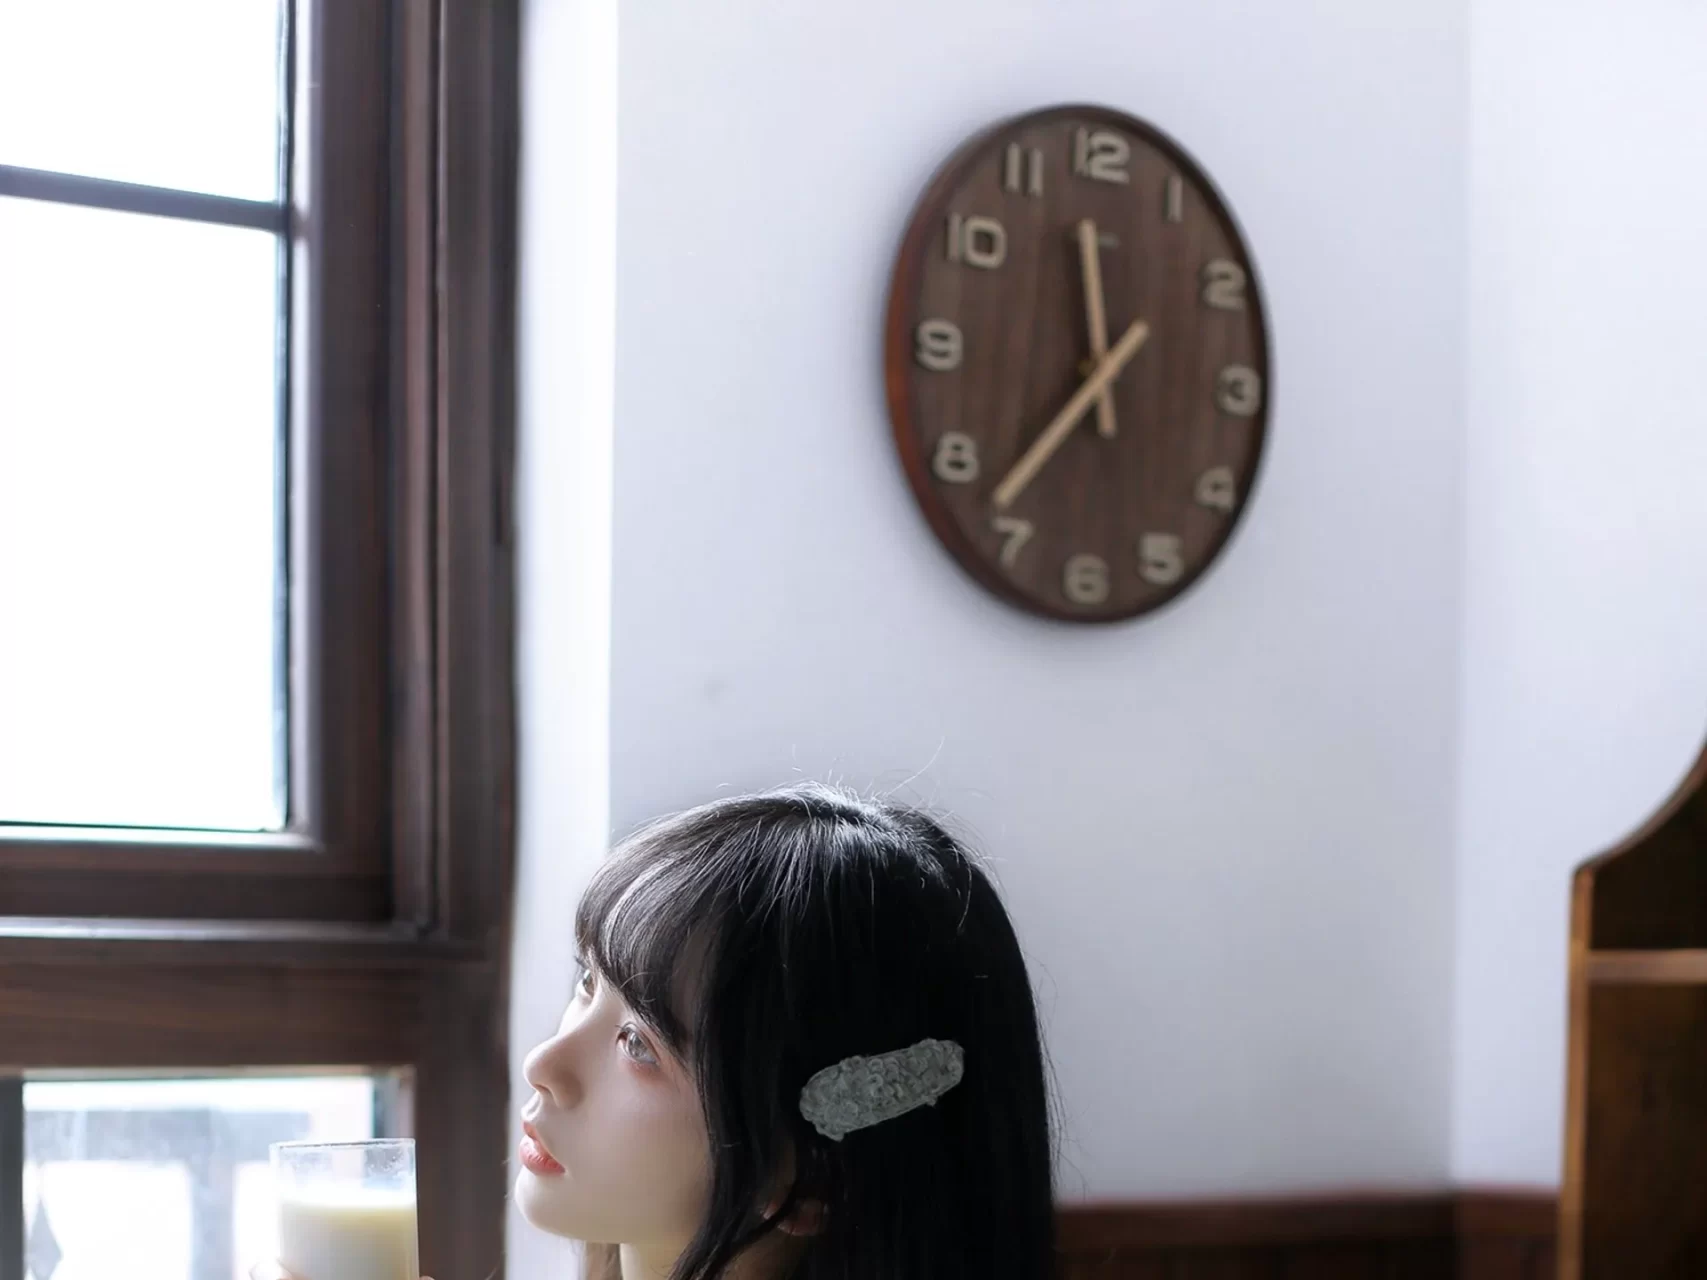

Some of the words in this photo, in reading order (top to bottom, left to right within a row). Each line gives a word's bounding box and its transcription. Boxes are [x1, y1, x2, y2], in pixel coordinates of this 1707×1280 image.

[1006, 142, 1043, 196] 11
[1075, 126, 1129, 184] 12
[1167, 175, 1182, 222] 1
[947, 212, 1005, 269] 10
[1204, 258, 1246, 309] 2
[916, 318, 963, 370] 9
[1219, 364, 1260, 416] 3
[934, 431, 979, 483] 8
[1196, 466, 1236, 513] 4
[993, 516, 1033, 567] 7
[1139, 533, 1183, 585] 5
[1064, 553, 1110, 604] 6
